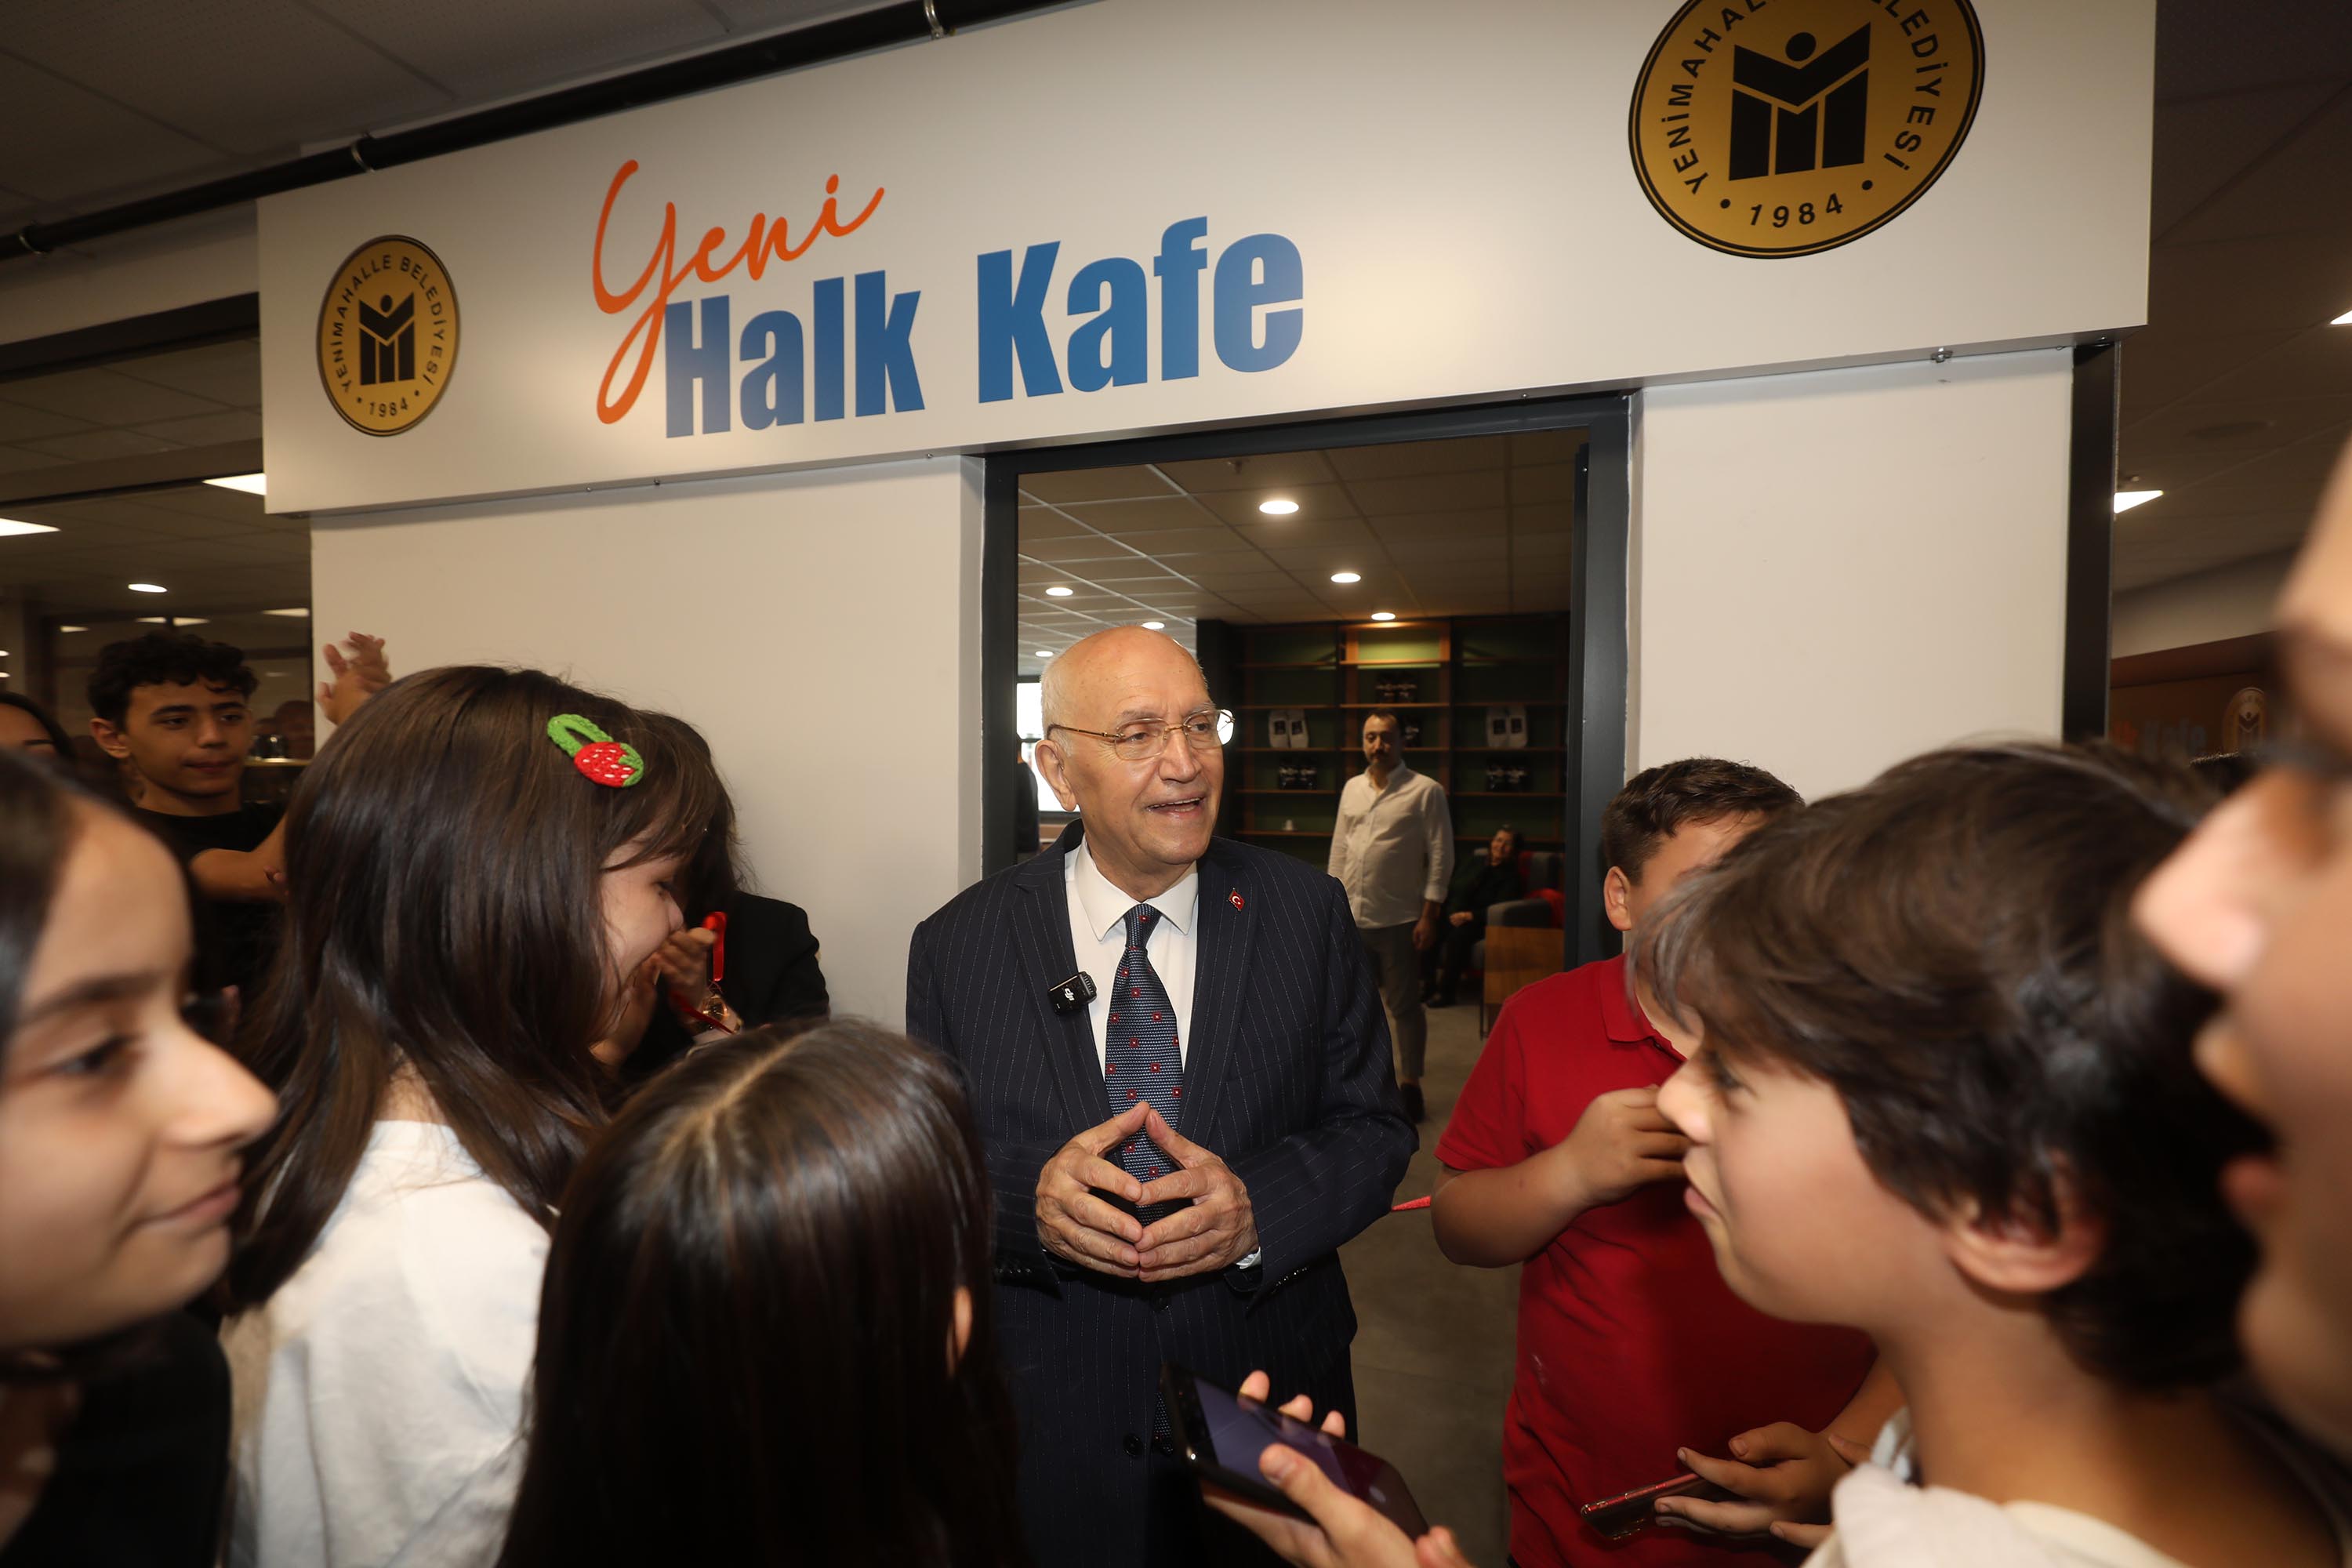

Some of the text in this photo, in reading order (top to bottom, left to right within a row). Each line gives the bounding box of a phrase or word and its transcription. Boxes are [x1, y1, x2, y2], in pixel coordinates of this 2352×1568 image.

[1661, 0, 1949, 194] YENİMAHAL LEDİYESİ
[592, 159, 885, 425] Yeni
[1749, 193, 1843, 228] 1984
[329, 254, 447, 393] YENİMAHALLE BELEDİYESİ
[665, 216, 1305, 439] Halk Kafe
[369, 397, 408, 418] 1984
